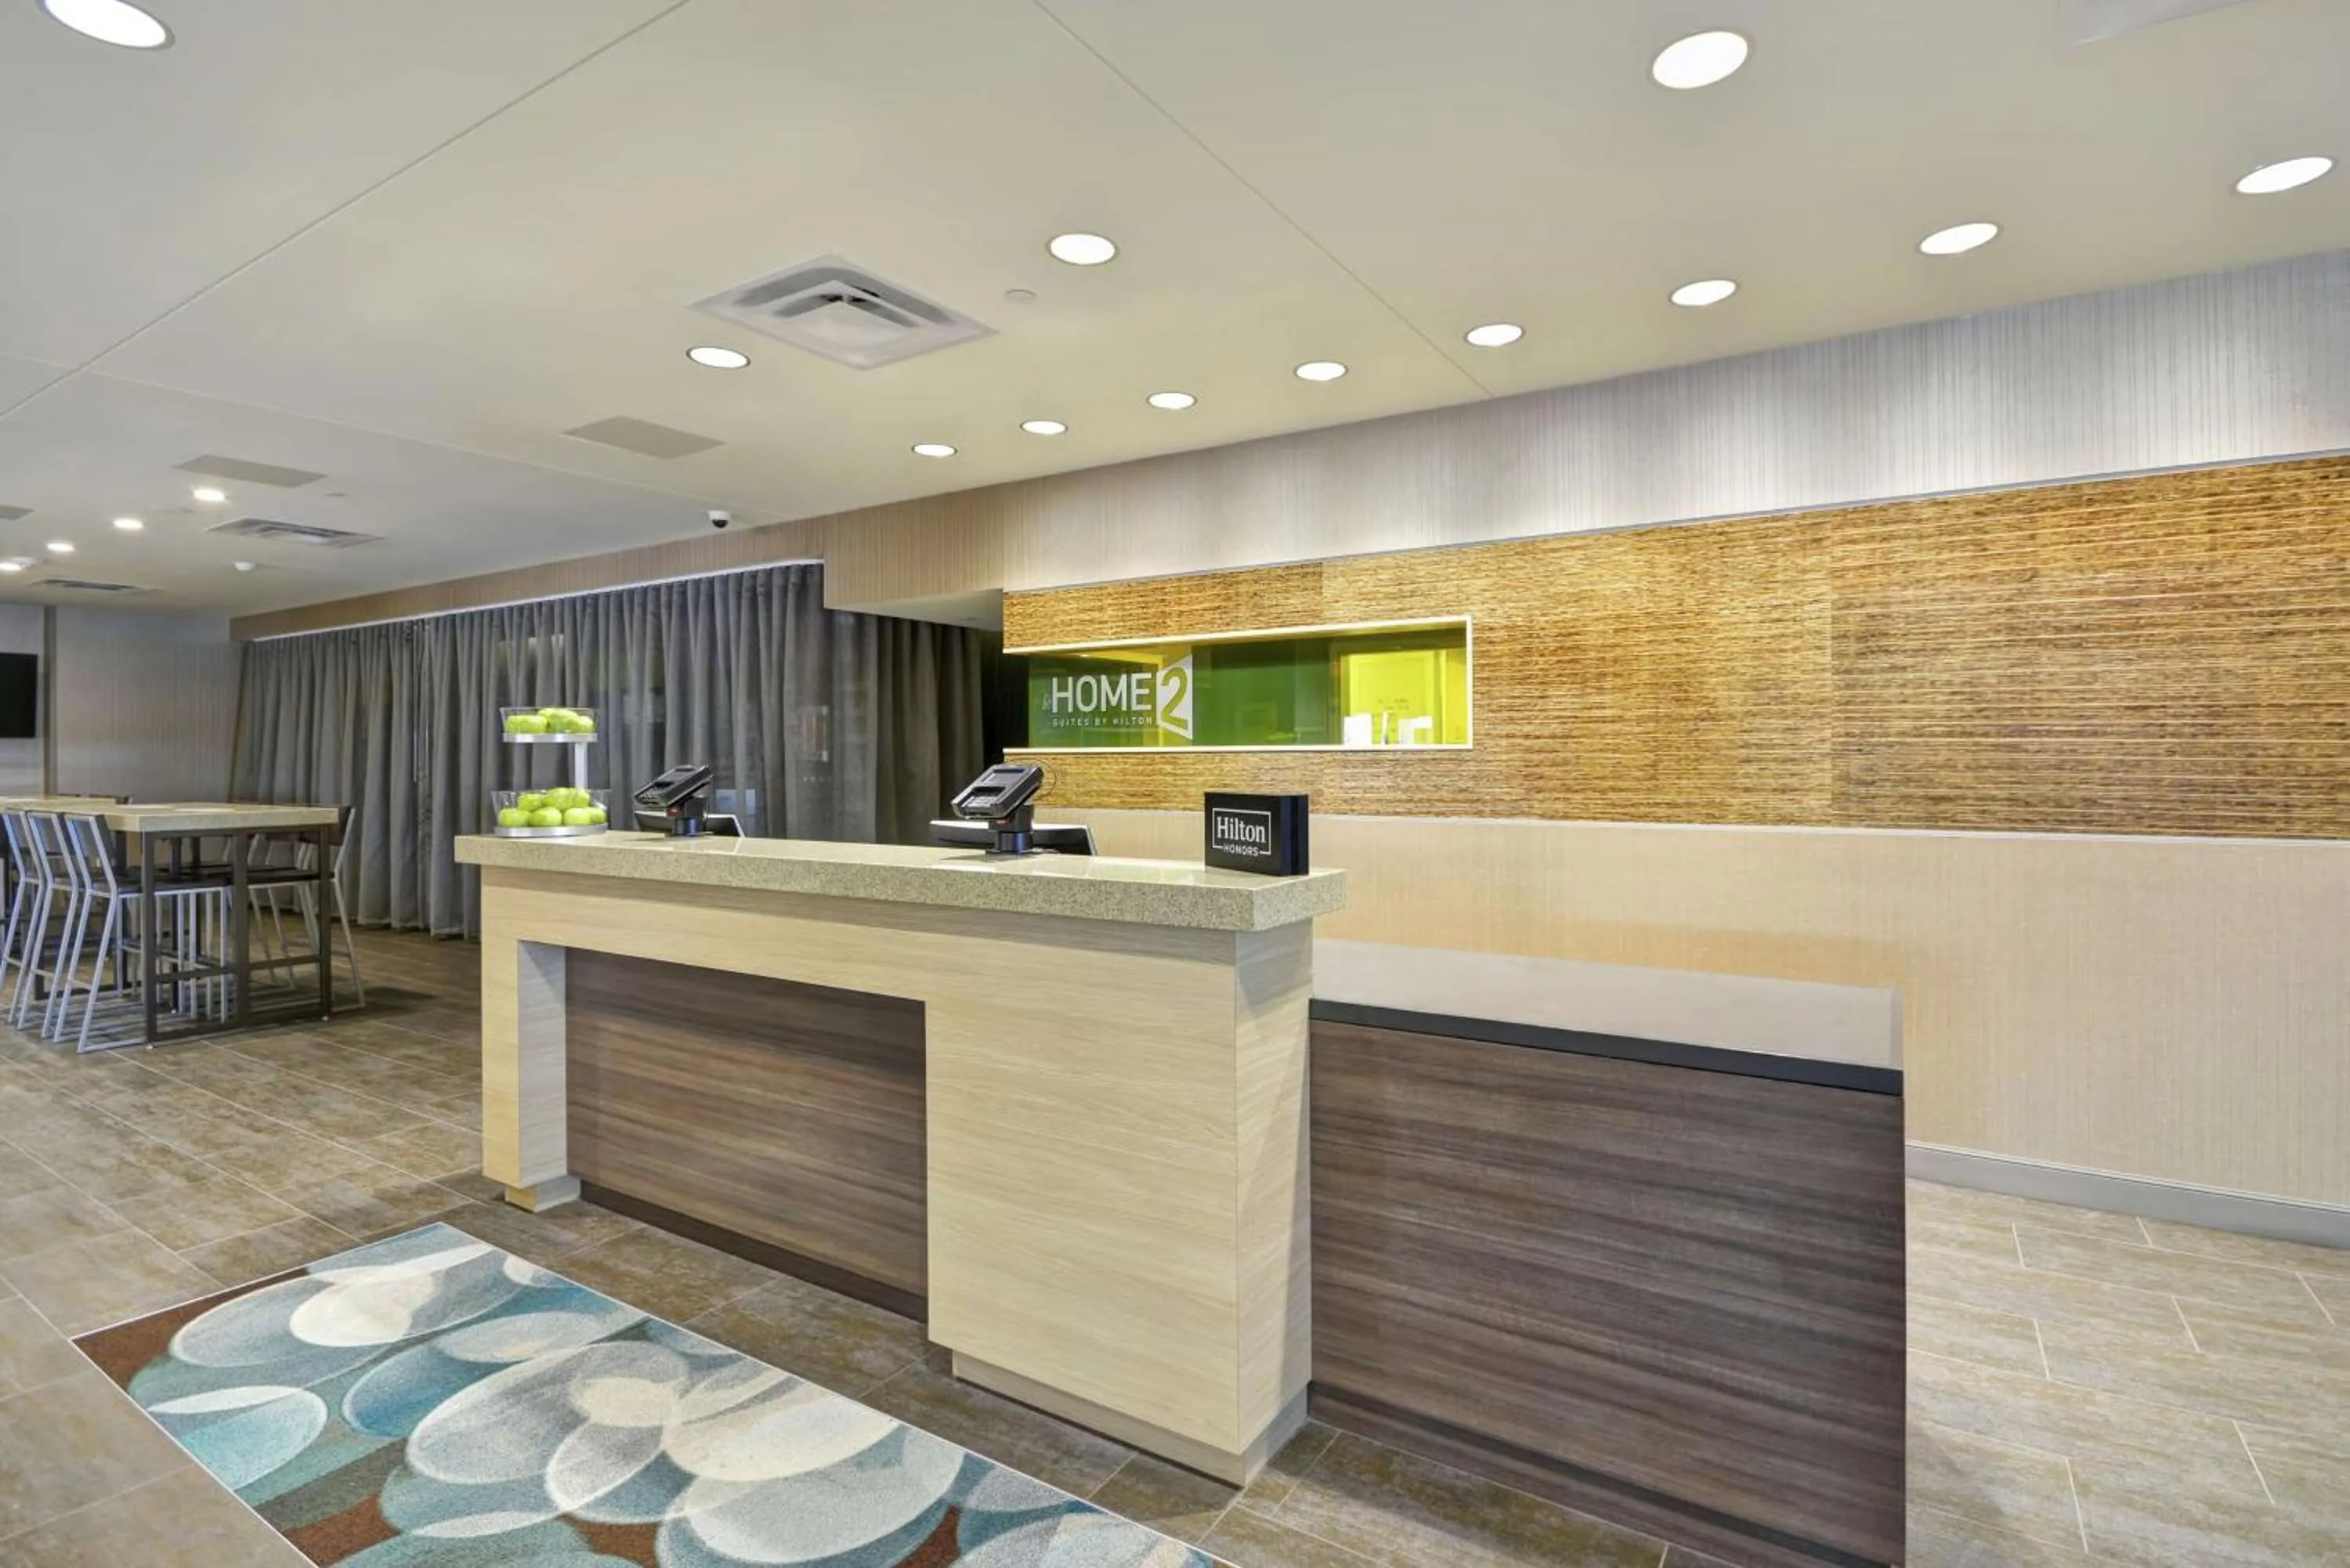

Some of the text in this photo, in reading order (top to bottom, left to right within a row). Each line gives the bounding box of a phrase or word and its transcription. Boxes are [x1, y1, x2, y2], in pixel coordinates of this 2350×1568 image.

[1052, 672, 1152, 714] HOME
[1052, 716, 1153, 728] SUITES BY HILTON
[1216, 816, 1266, 844] Hilton
[1223, 844, 1260, 857] HONORS
